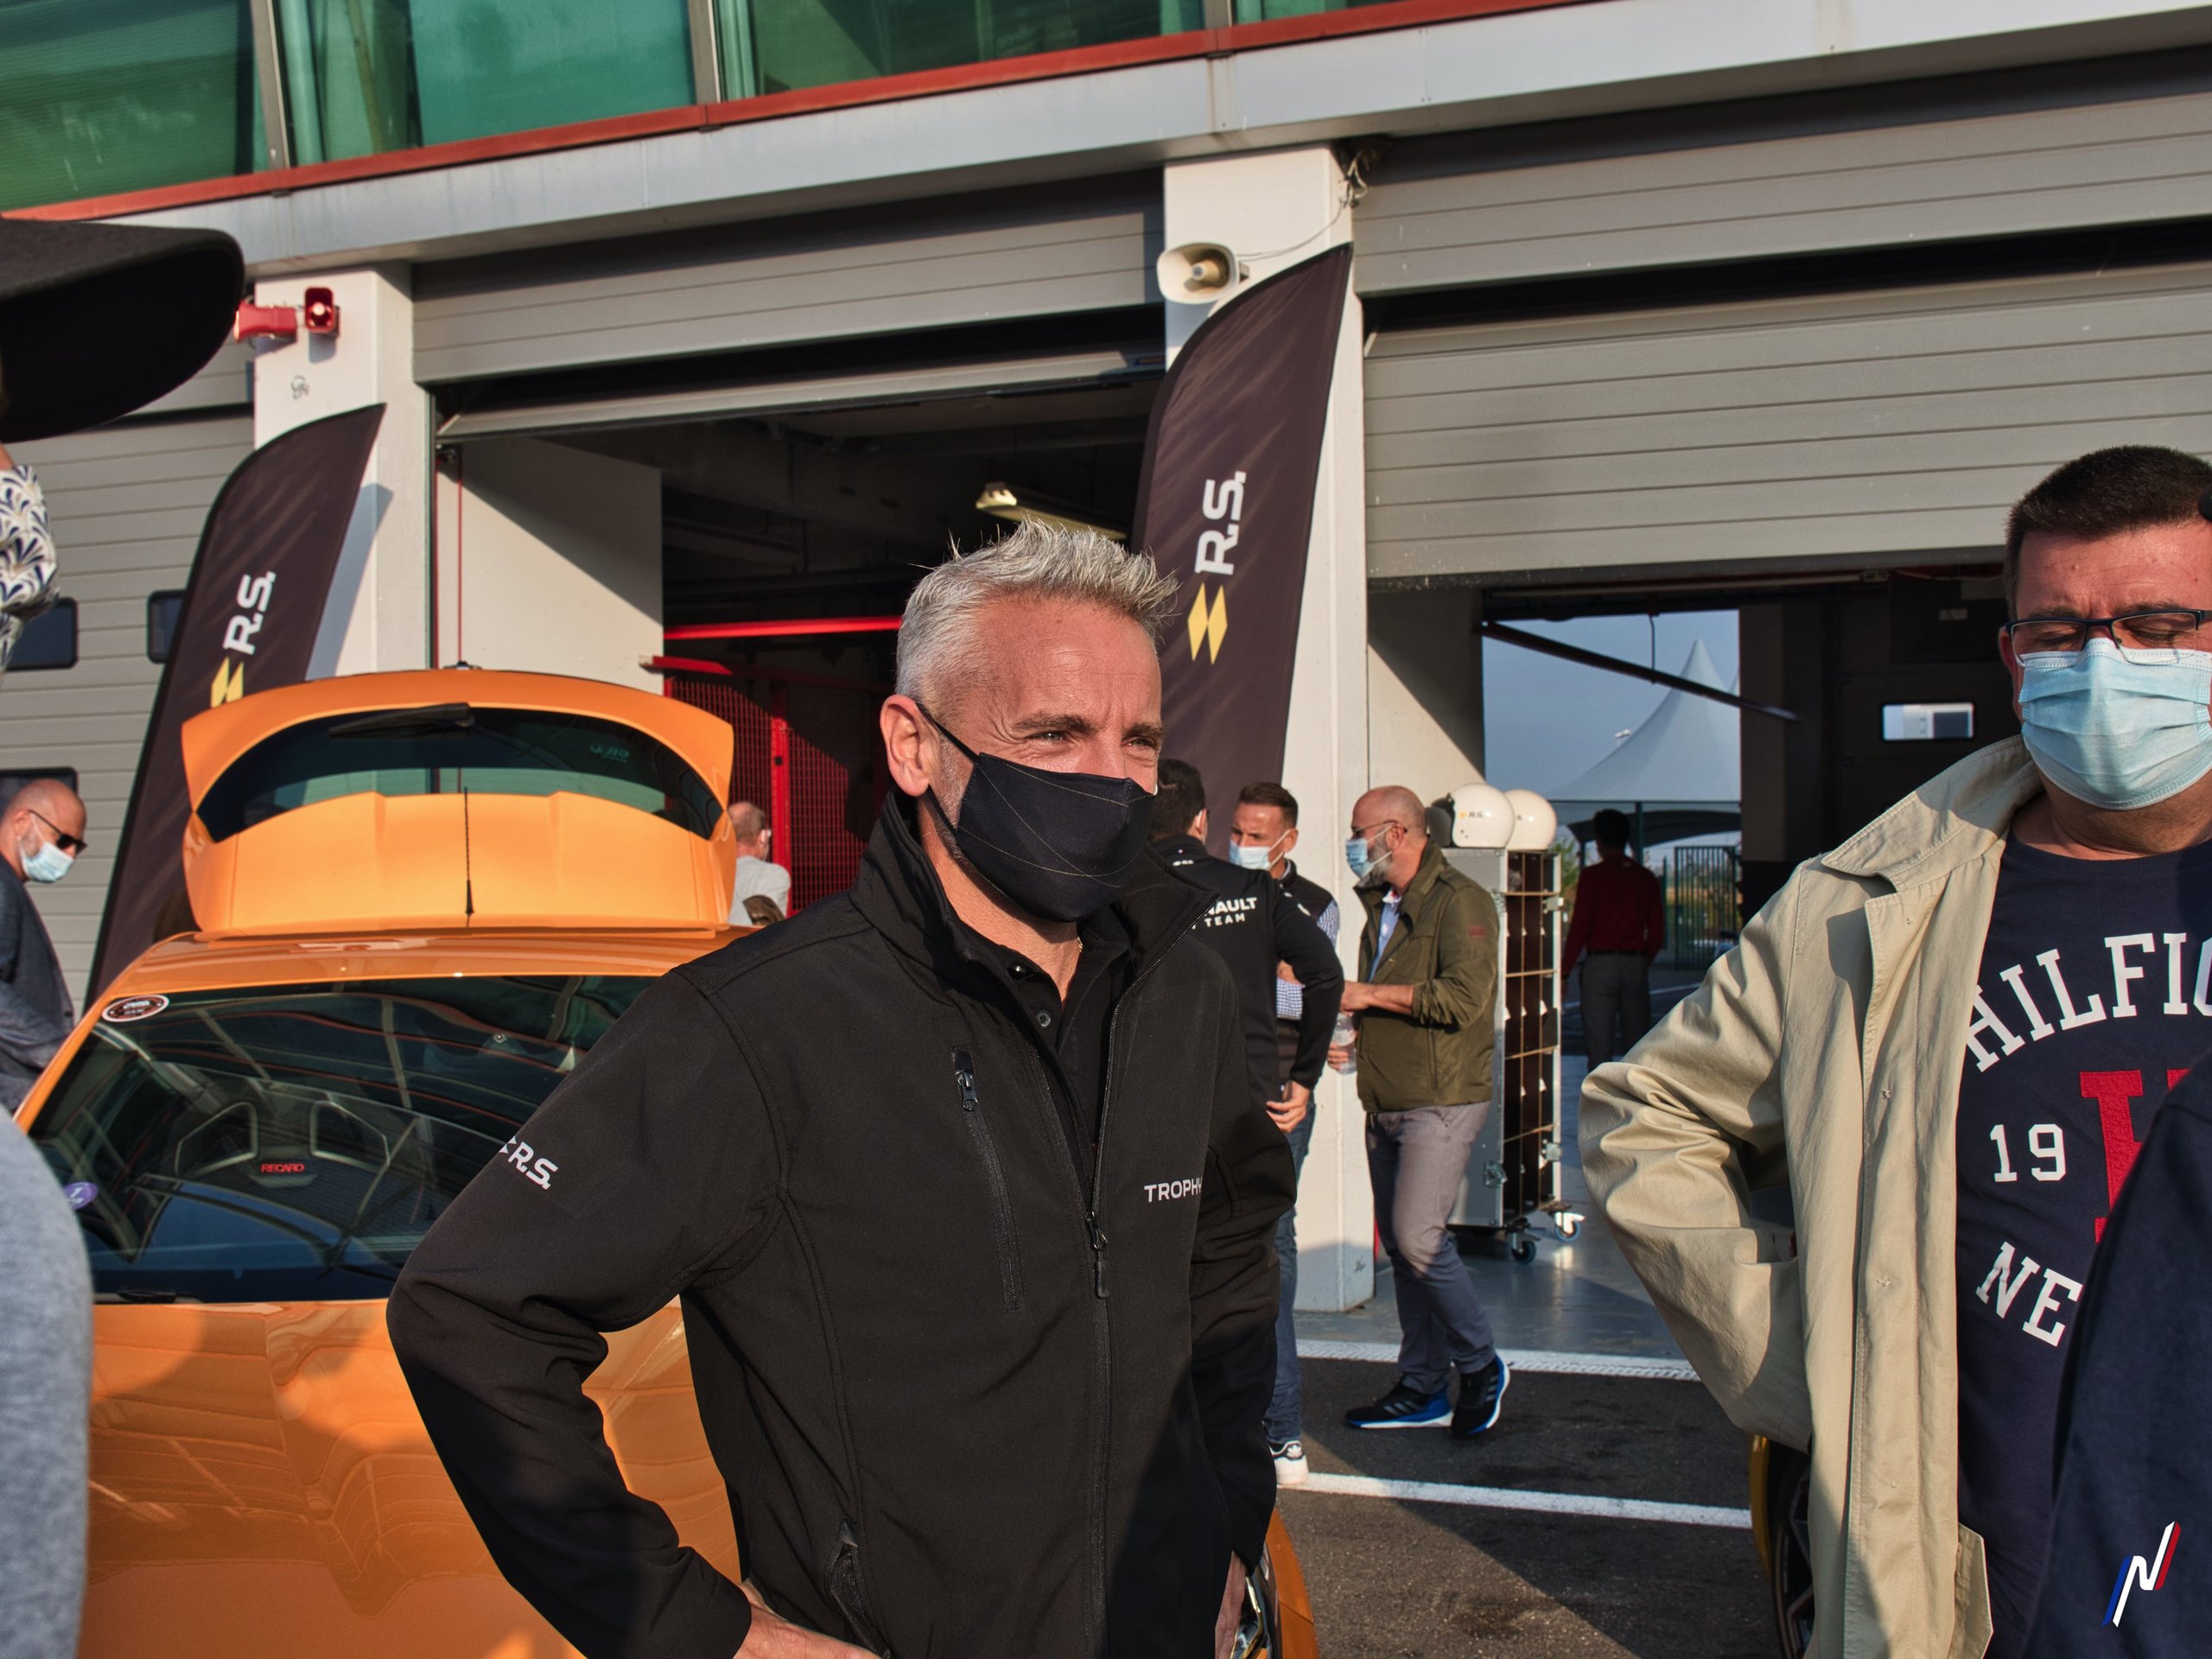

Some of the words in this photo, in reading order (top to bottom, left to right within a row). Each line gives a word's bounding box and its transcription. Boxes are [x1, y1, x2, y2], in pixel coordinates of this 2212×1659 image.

[1194, 470, 1247, 575] R.S.
[222, 571, 276, 655] R.S.
[1205, 913, 1245, 927] TEAM
[261, 1163, 304, 1173] RECARO
[508, 1141, 558, 1190] R.S.
[1990, 1123, 2066, 1181] 19
